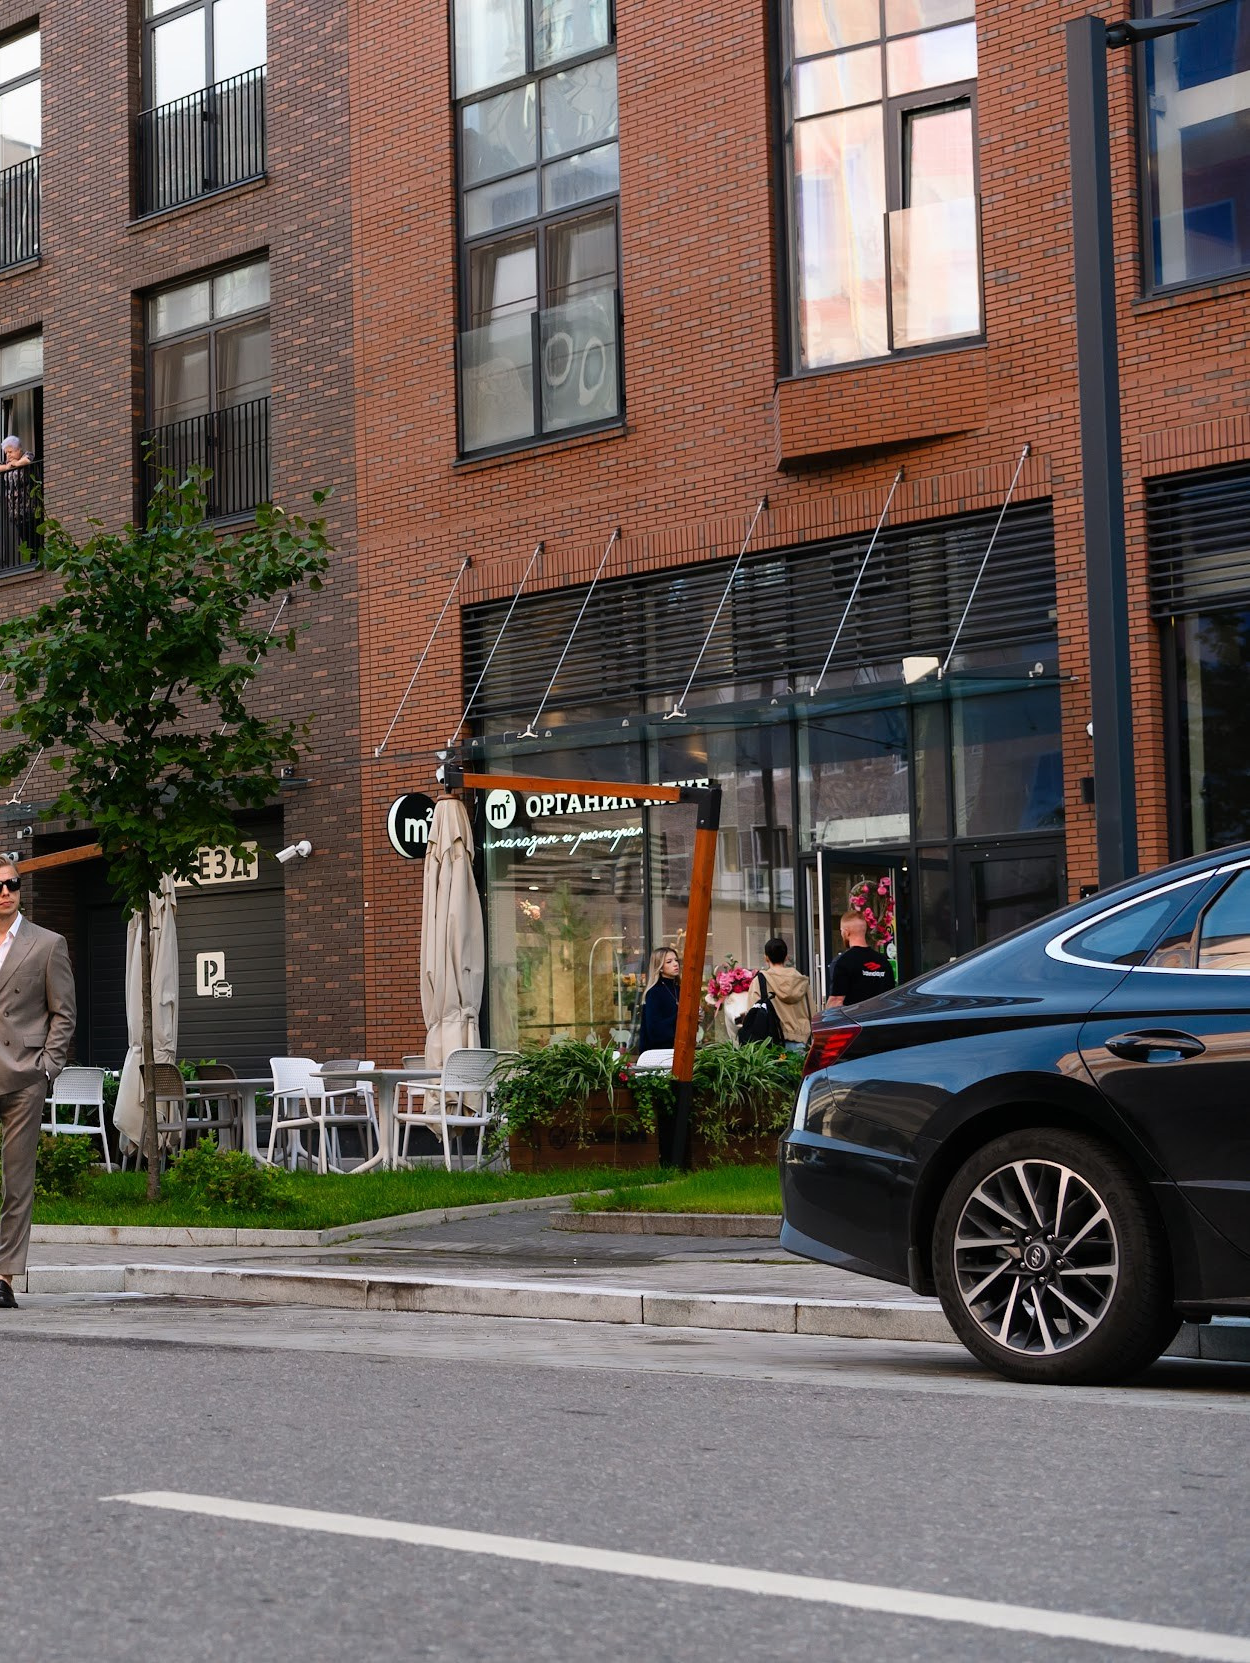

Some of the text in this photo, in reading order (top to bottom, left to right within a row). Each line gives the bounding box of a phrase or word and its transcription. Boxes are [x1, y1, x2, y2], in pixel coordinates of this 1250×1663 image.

[526, 793, 636, 818] ОРГАНИК
[562, 834, 576, 843] и
[204, 960, 218, 987] P
